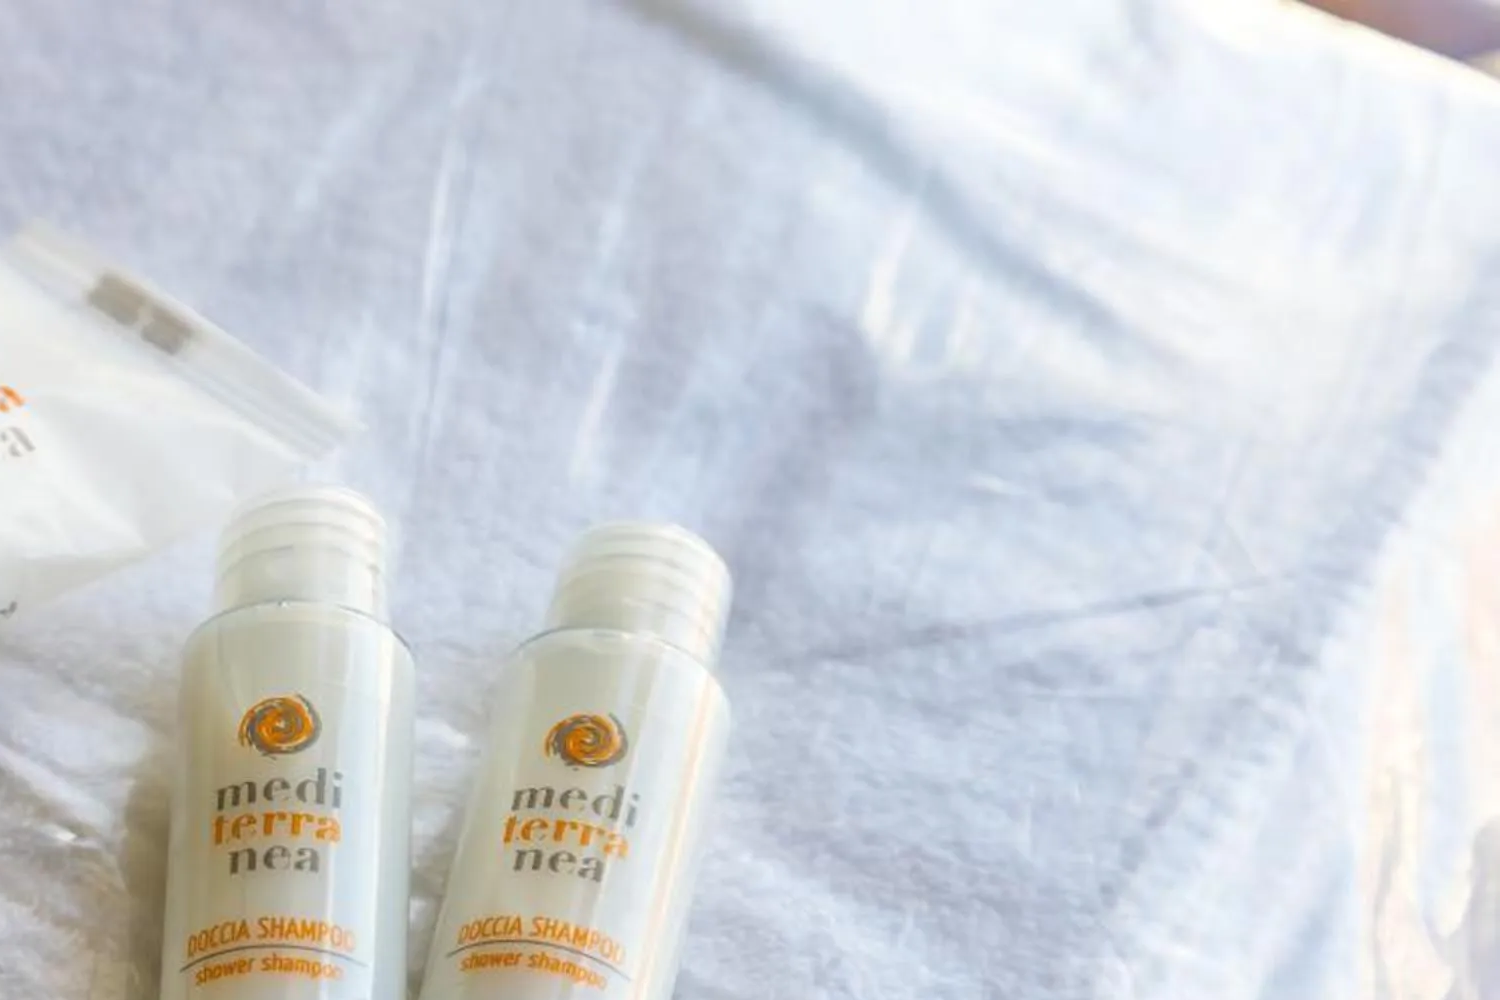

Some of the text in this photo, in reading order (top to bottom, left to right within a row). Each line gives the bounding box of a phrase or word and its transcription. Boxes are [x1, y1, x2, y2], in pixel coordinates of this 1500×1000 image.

[216, 768, 344, 811] medi
[511, 784, 640, 828] medi
[212, 810, 341, 845] terra
[502, 815, 629, 856] terra
[228, 845, 320, 875] nea
[512, 848, 606, 883] nea
[187, 915, 357, 957] DOCCIA SHAMPOO
[457, 915, 626, 965] DOCCIA SHAMPOO
[195, 951, 344, 986] shower shampoo
[459, 948, 607, 990] shower shampoo
